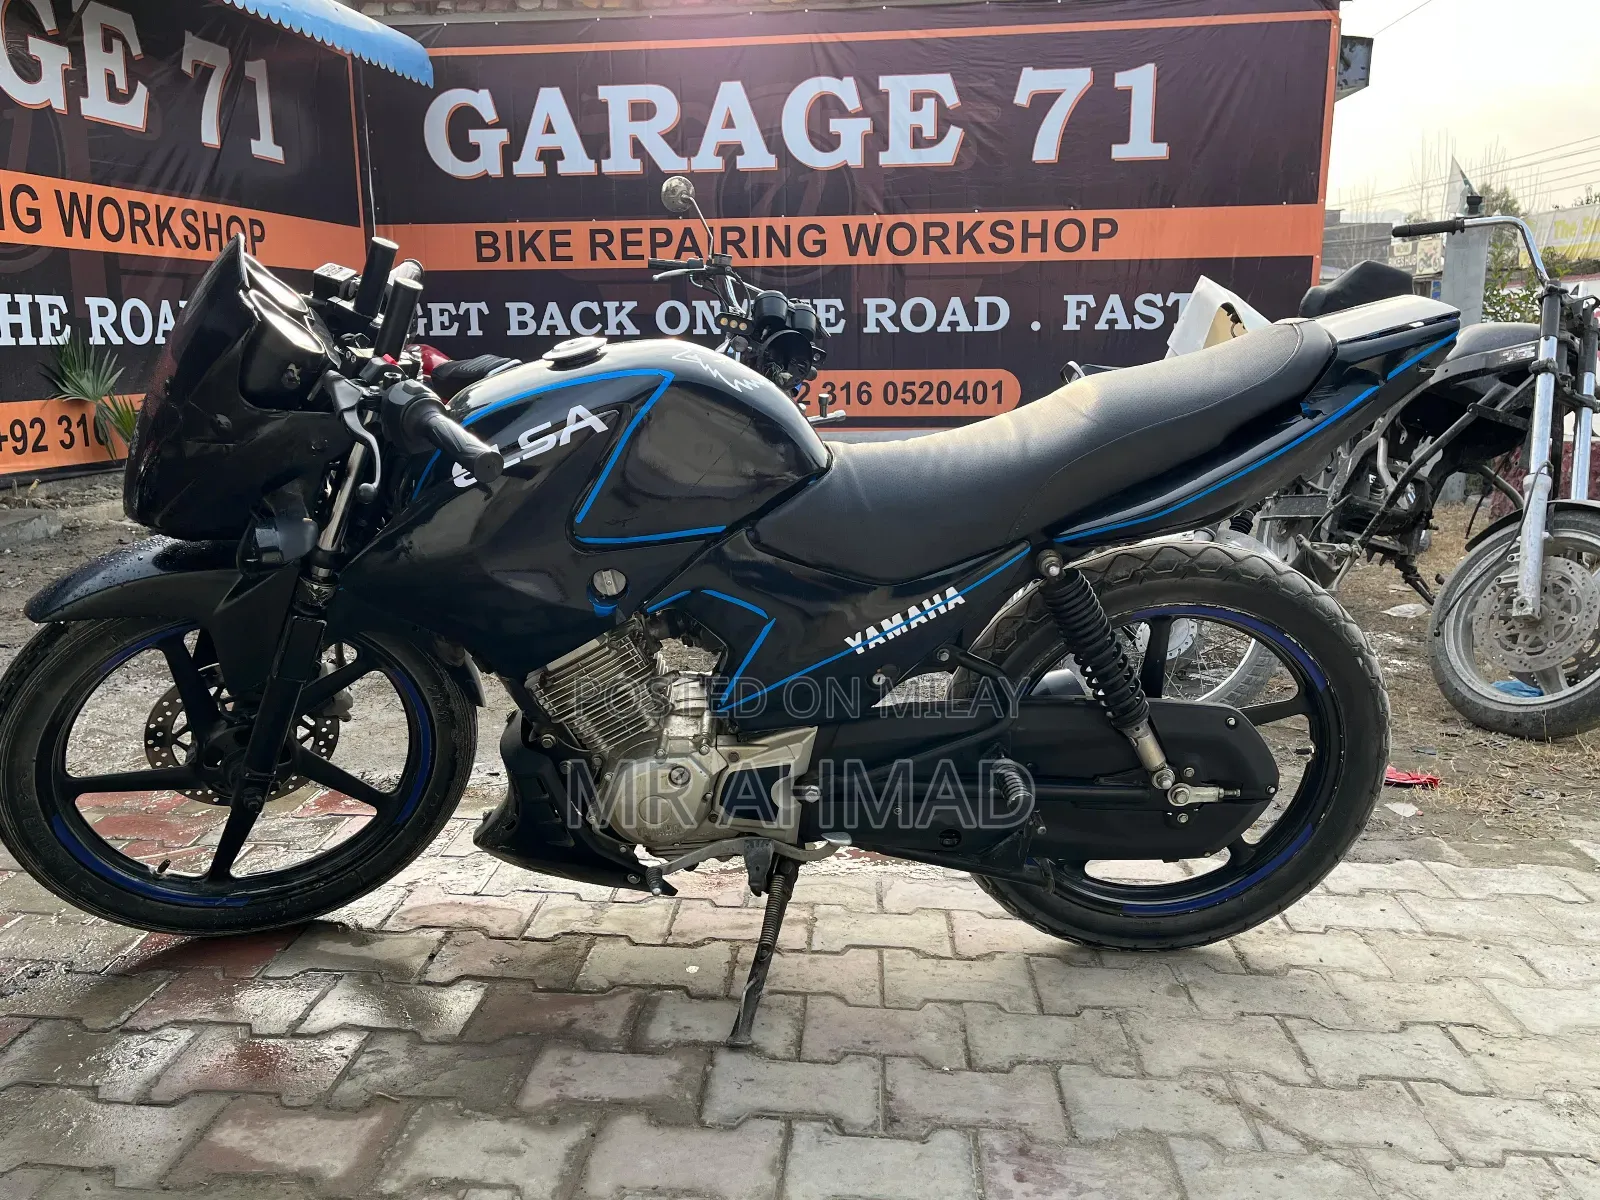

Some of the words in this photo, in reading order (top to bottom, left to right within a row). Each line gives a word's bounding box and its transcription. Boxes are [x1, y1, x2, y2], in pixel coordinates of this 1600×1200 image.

[181, 30, 285, 164] 71
[423, 73, 965, 178] GARAGE
[1013, 62, 1170, 163] 71
[0, 184, 42, 234] G
[54, 189, 266, 256] WORKSHOP
[475, 228, 573, 263] BIKE
[589, 224, 827, 263] REPAIRING
[843, 217, 1119, 257] WORKSHOP
[85, 296, 187, 345] ROA
[505, 301, 640, 335] BACK
[655, 300, 721, 335] ON
[863, 295, 1011, 333] ROAD
[1062, 291, 1193, 331] FAST
[822, 380, 873, 406] 316
[882, 380, 1004, 406] 0520401
[843, 586, 966, 655] YAMAHA
